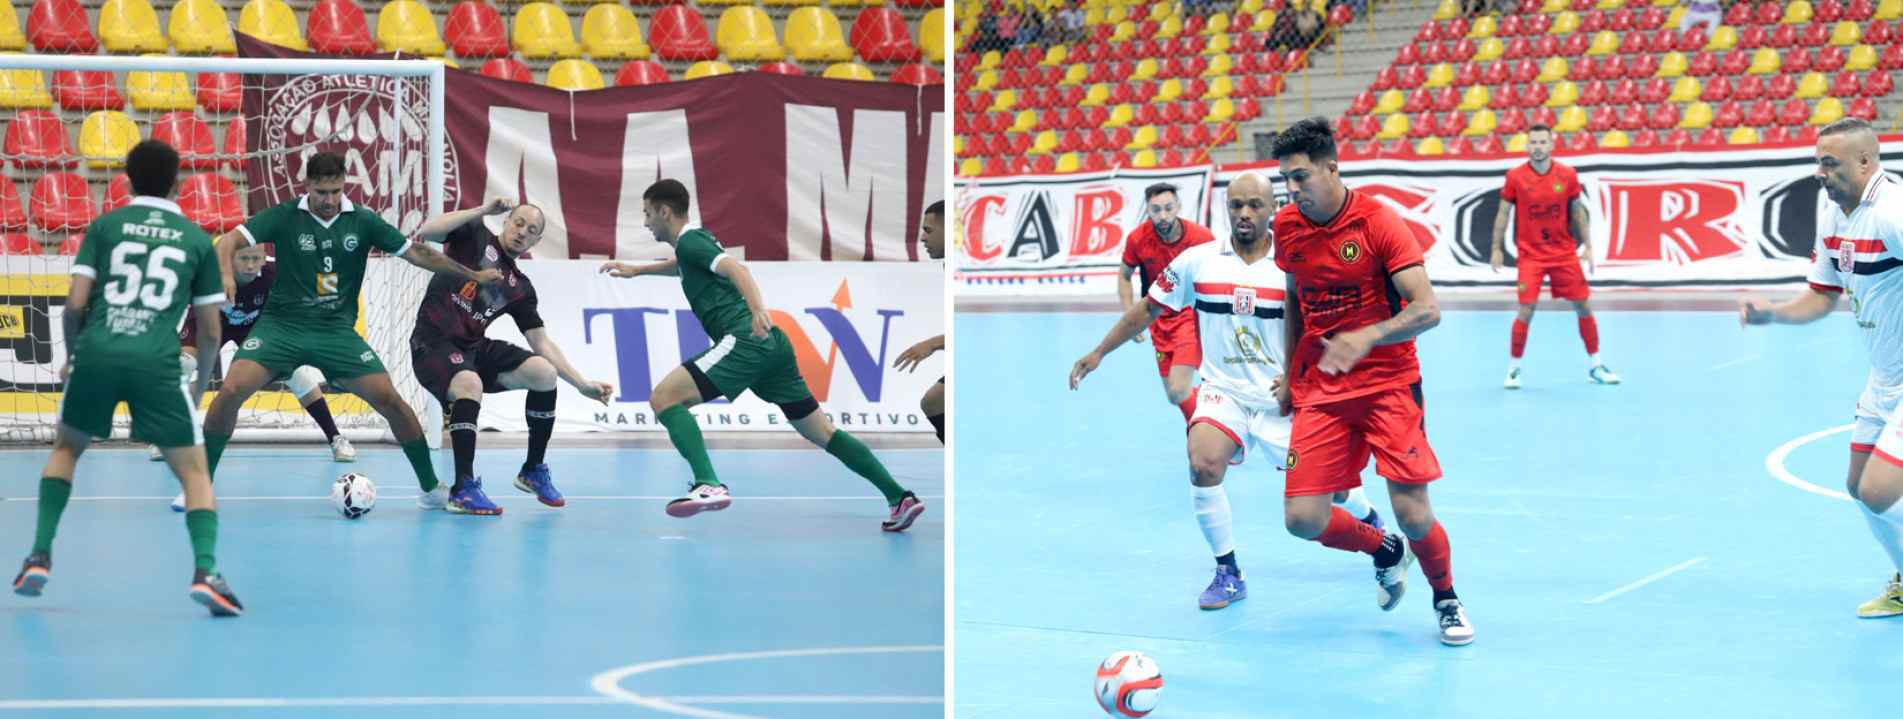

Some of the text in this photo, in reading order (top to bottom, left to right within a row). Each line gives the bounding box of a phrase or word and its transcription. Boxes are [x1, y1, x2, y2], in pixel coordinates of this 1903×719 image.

[785, 103, 944, 260] M
[122, 222, 183, 241] ROTEX
[962, 186, 1148, 263] CAB
[103, 240, 187, 311] 55
[323, 256, 333, 273] 9
[594, 412, 919, 425] MARING EORTIVO
